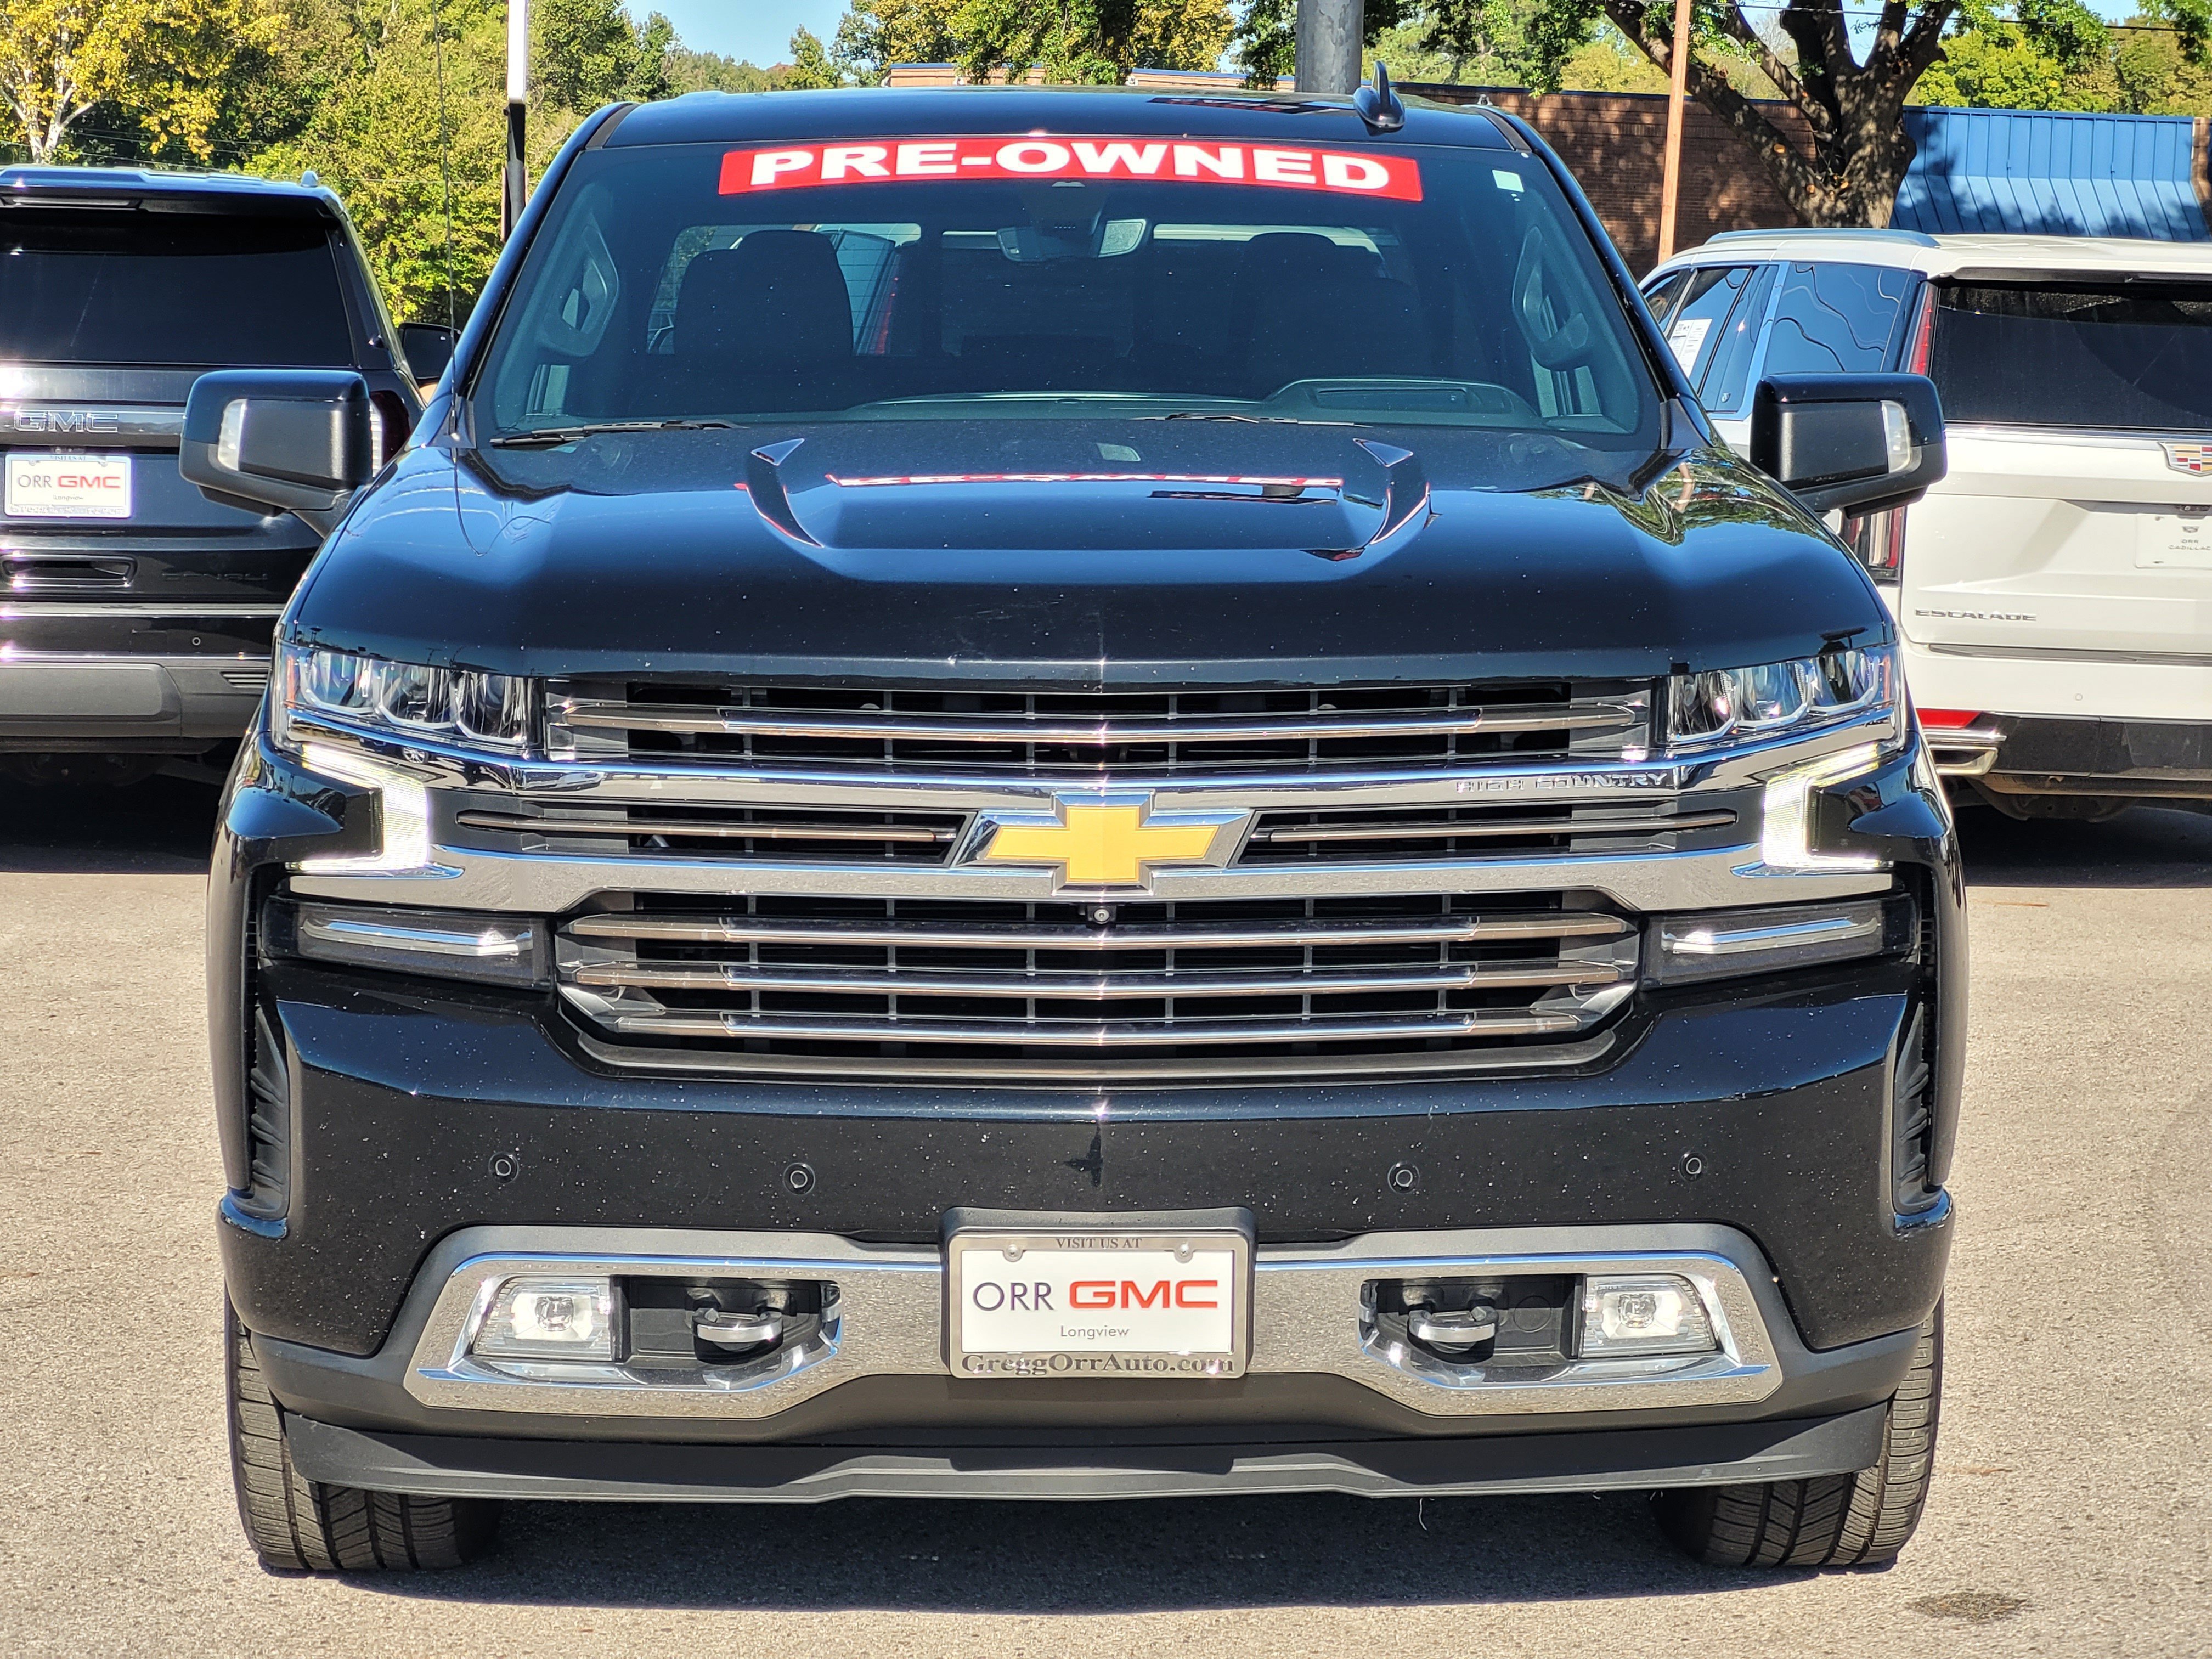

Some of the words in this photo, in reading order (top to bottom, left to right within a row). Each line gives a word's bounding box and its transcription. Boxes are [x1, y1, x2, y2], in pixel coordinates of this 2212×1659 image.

[751, 142, 1389, 189] PRE-OWNED
[14, 411, 118, 432] GMC
[18, 475, 52, 488] ORR
[58, 476, 121, 489] GMC
[1915, 608, 2037, 621] ESCALADE
[1457, 778, 1525, 793] HIGH
[1536, 772, 1667, 790] COUNTRY
[1056, 1238, 1096, 1249] VISIT
[1100, 1238, 1118, 1249] US
[1122, 1238, 1142, 1248] AT
[973, 1282, 1056, 1311] ORR
[1069, 1280, 1218, 1309] GMC
[1060, 1325, 1130, 1340] Longview
[961, 1353, 1234, 1376] GreggOrrAuto.com
